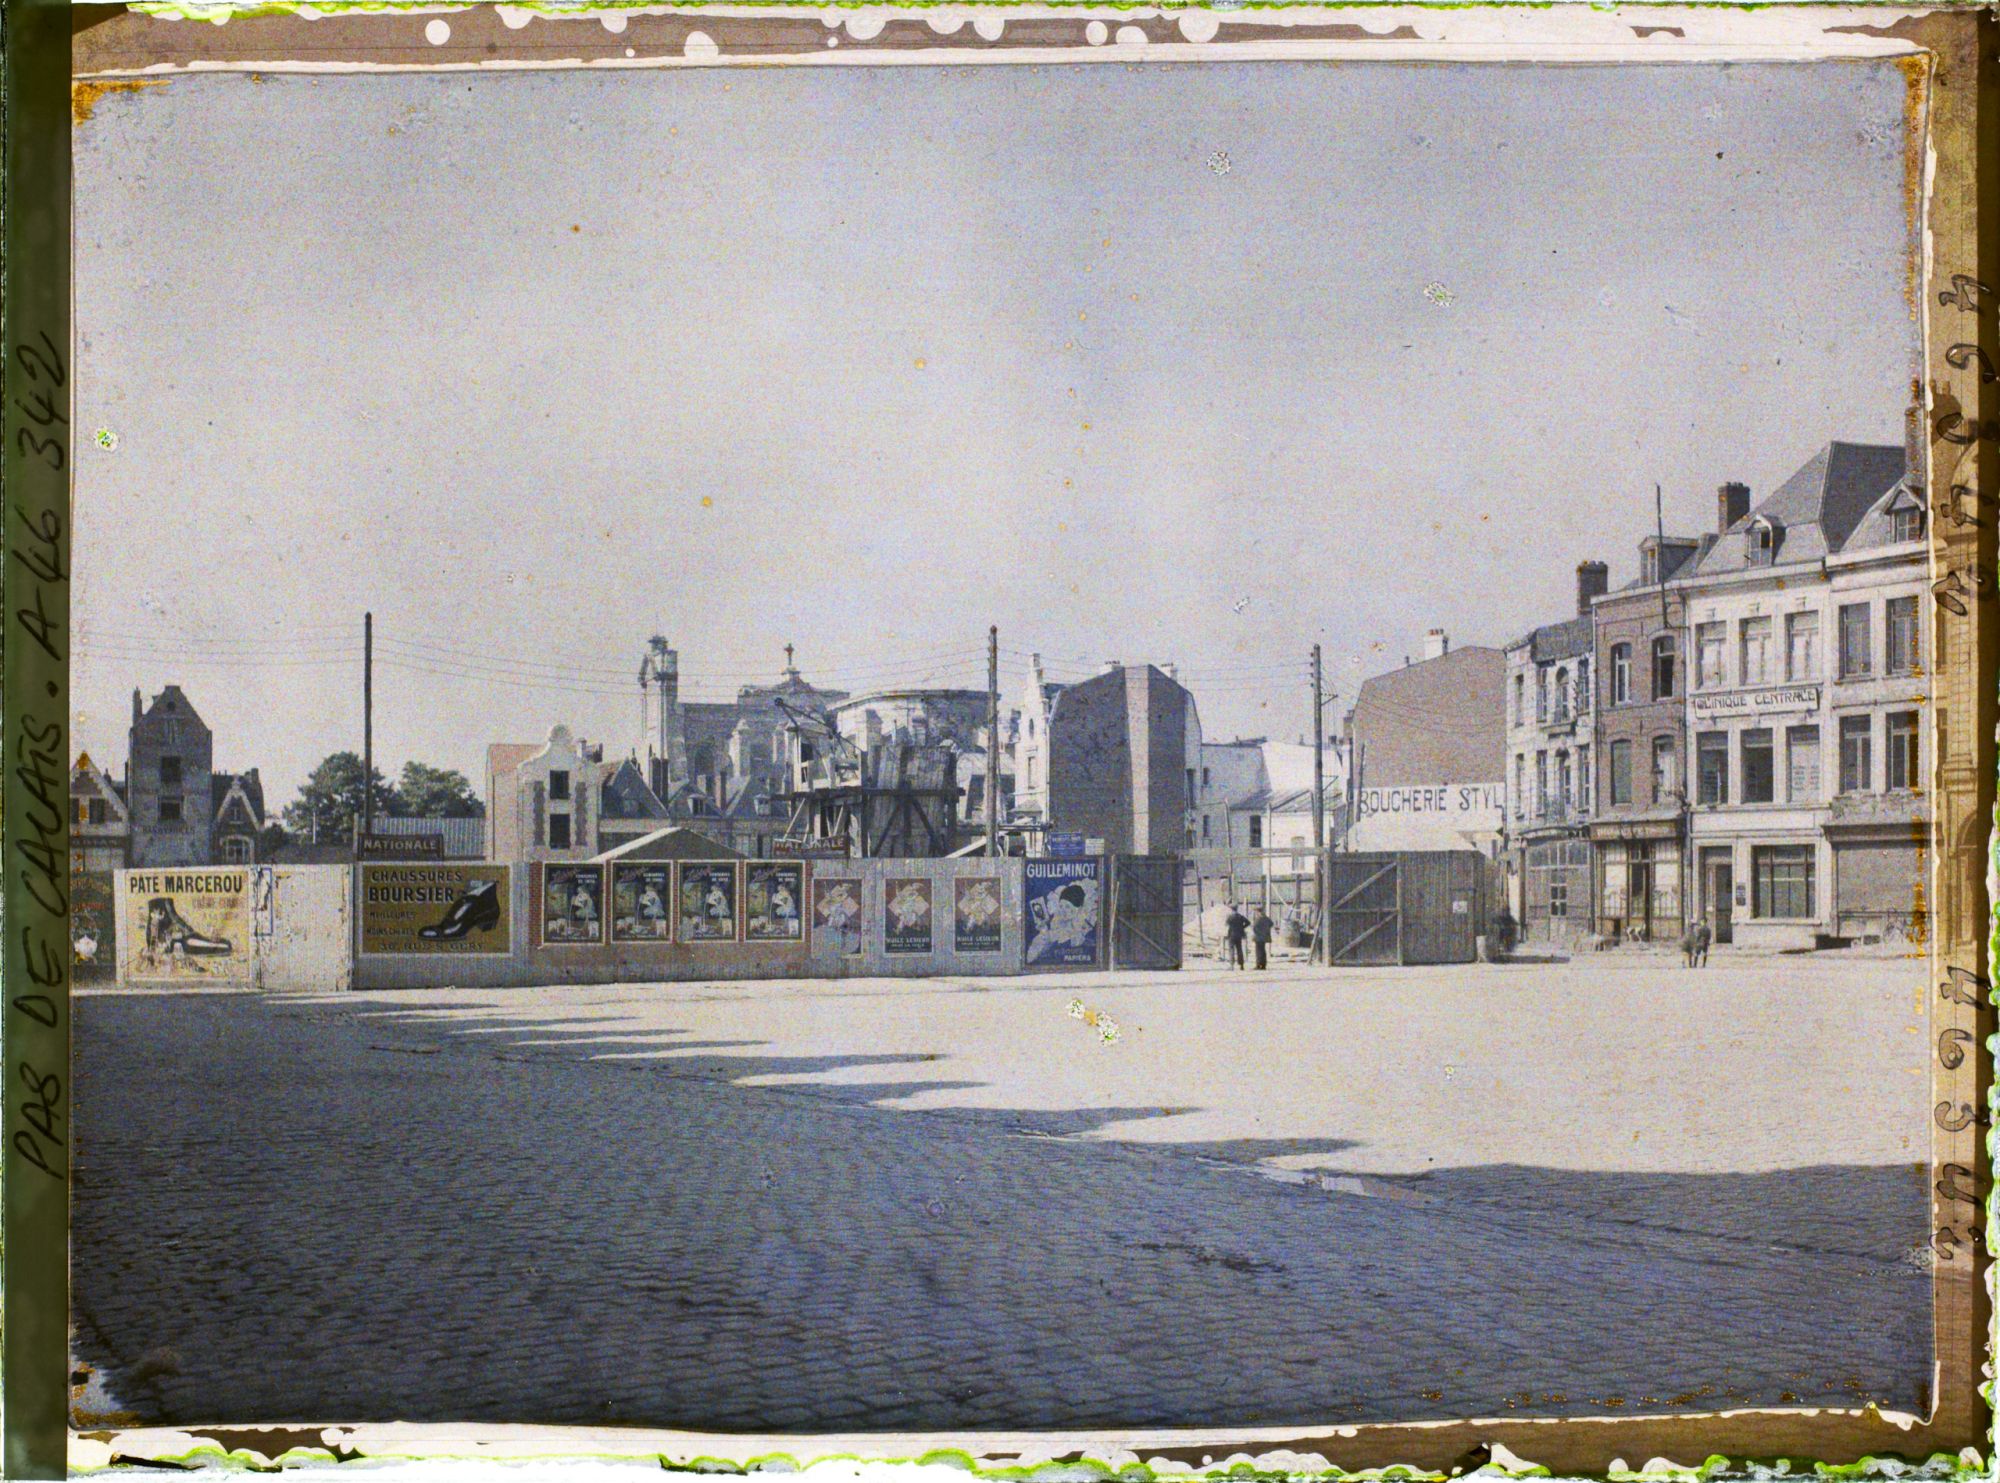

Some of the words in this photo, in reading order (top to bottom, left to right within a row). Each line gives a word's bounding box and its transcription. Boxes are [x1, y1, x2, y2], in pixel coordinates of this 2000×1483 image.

[15, 330, 70, 471] 342
[1696, 696, 1747, 710] CLINIQUE
[1754, 690, 1815, 705] CENTRALE
[1359, 788, 1448, 814] BOUCHERIE
[363, 839, 438, 851] NATIONALE
[371, 870, 464, 883] CHAUSSURES
[1026, 863, 1096, 878] GUILLEMINOT
[165, 875, 243, 894] MARCEROU
[367, 886, 456, 904] BOURSIER
[12, 926, 64, 1029] DE
[13, 1061, 65, 1180] PAS
